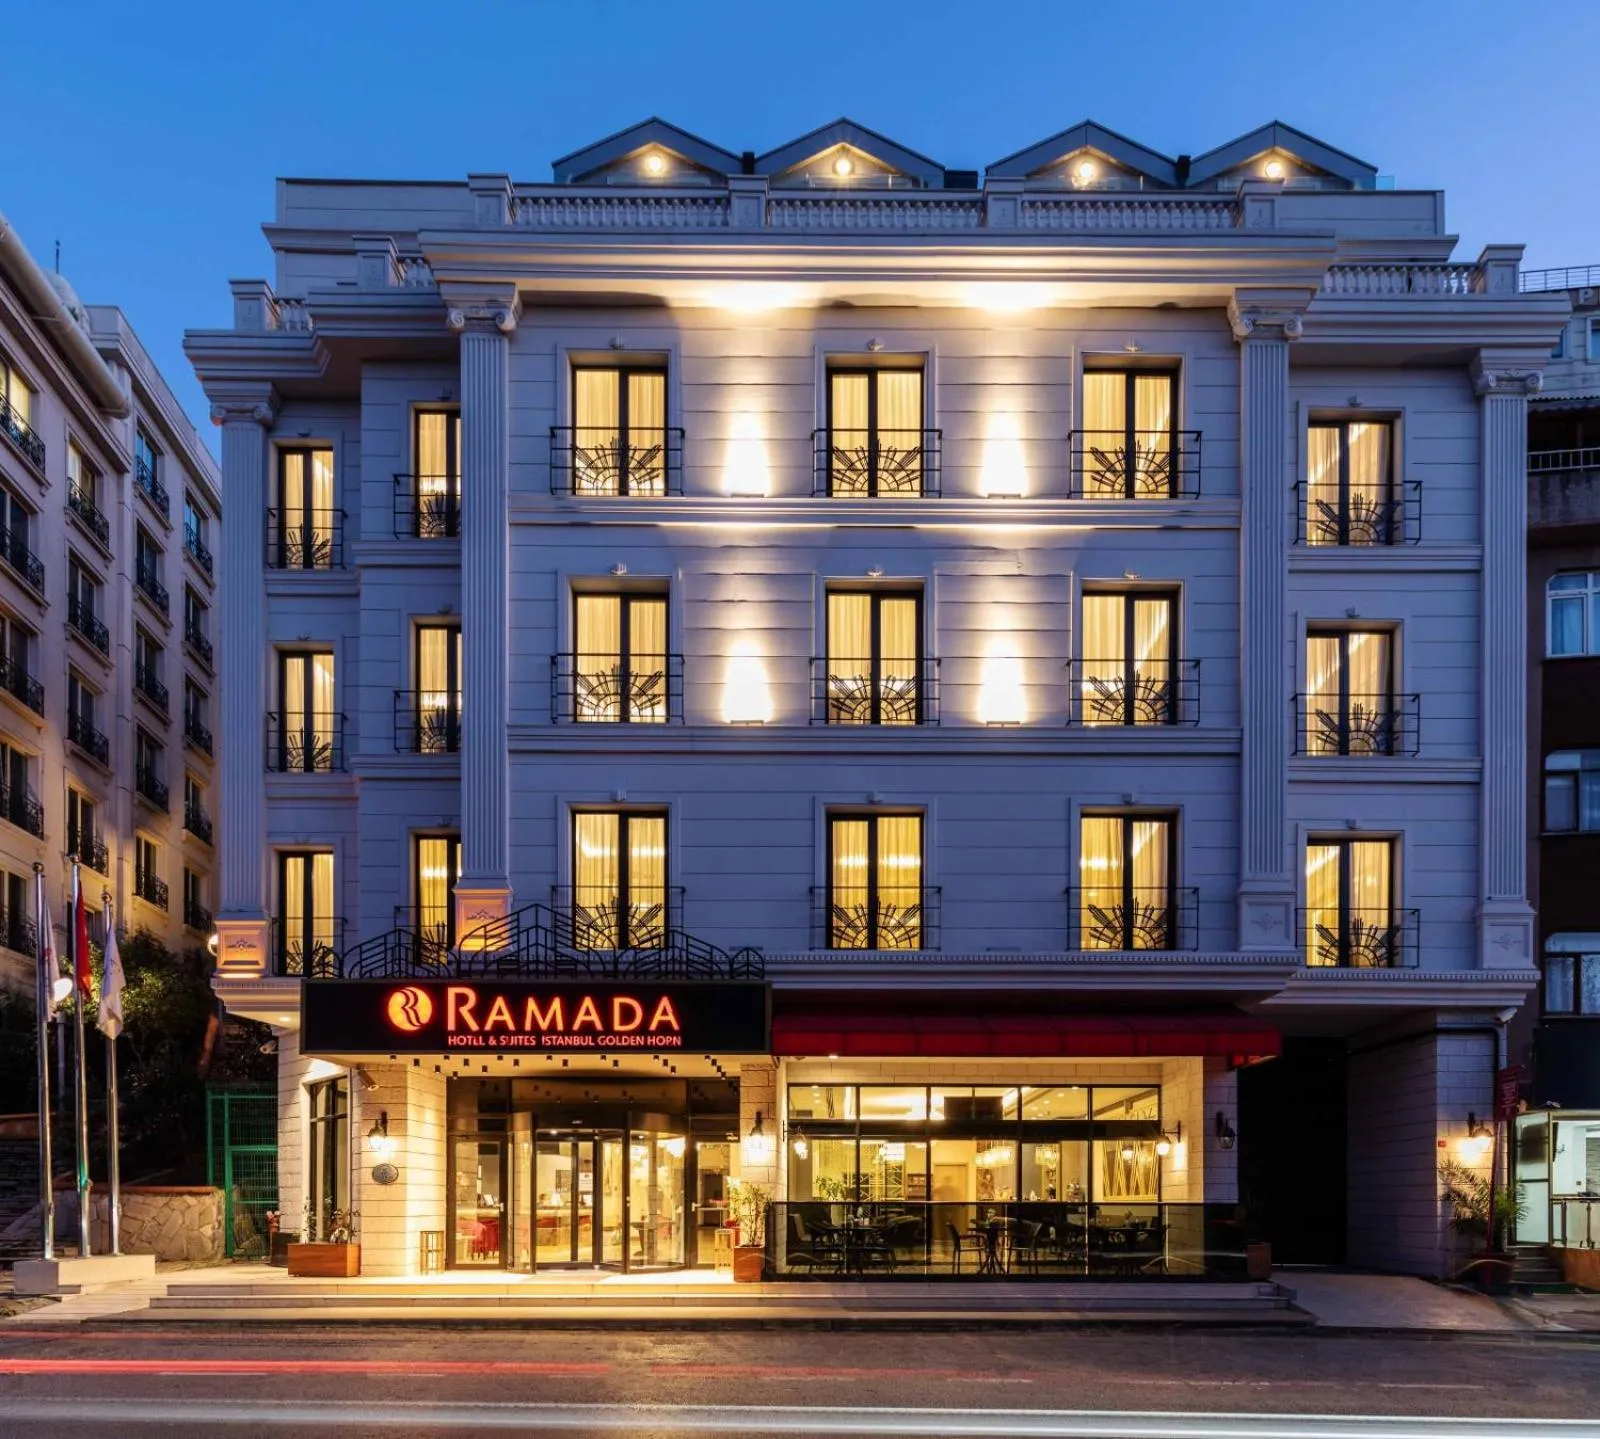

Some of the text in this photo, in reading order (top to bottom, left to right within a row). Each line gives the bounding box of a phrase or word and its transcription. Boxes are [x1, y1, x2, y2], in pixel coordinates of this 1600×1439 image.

[447, 986, 680, 1031] RAMADA
[488, 1035, 497, 1046] &
[542, 1035, 595, 1046] ISTANBUL
[597, 1035, 645, 1046] GOLDEN
